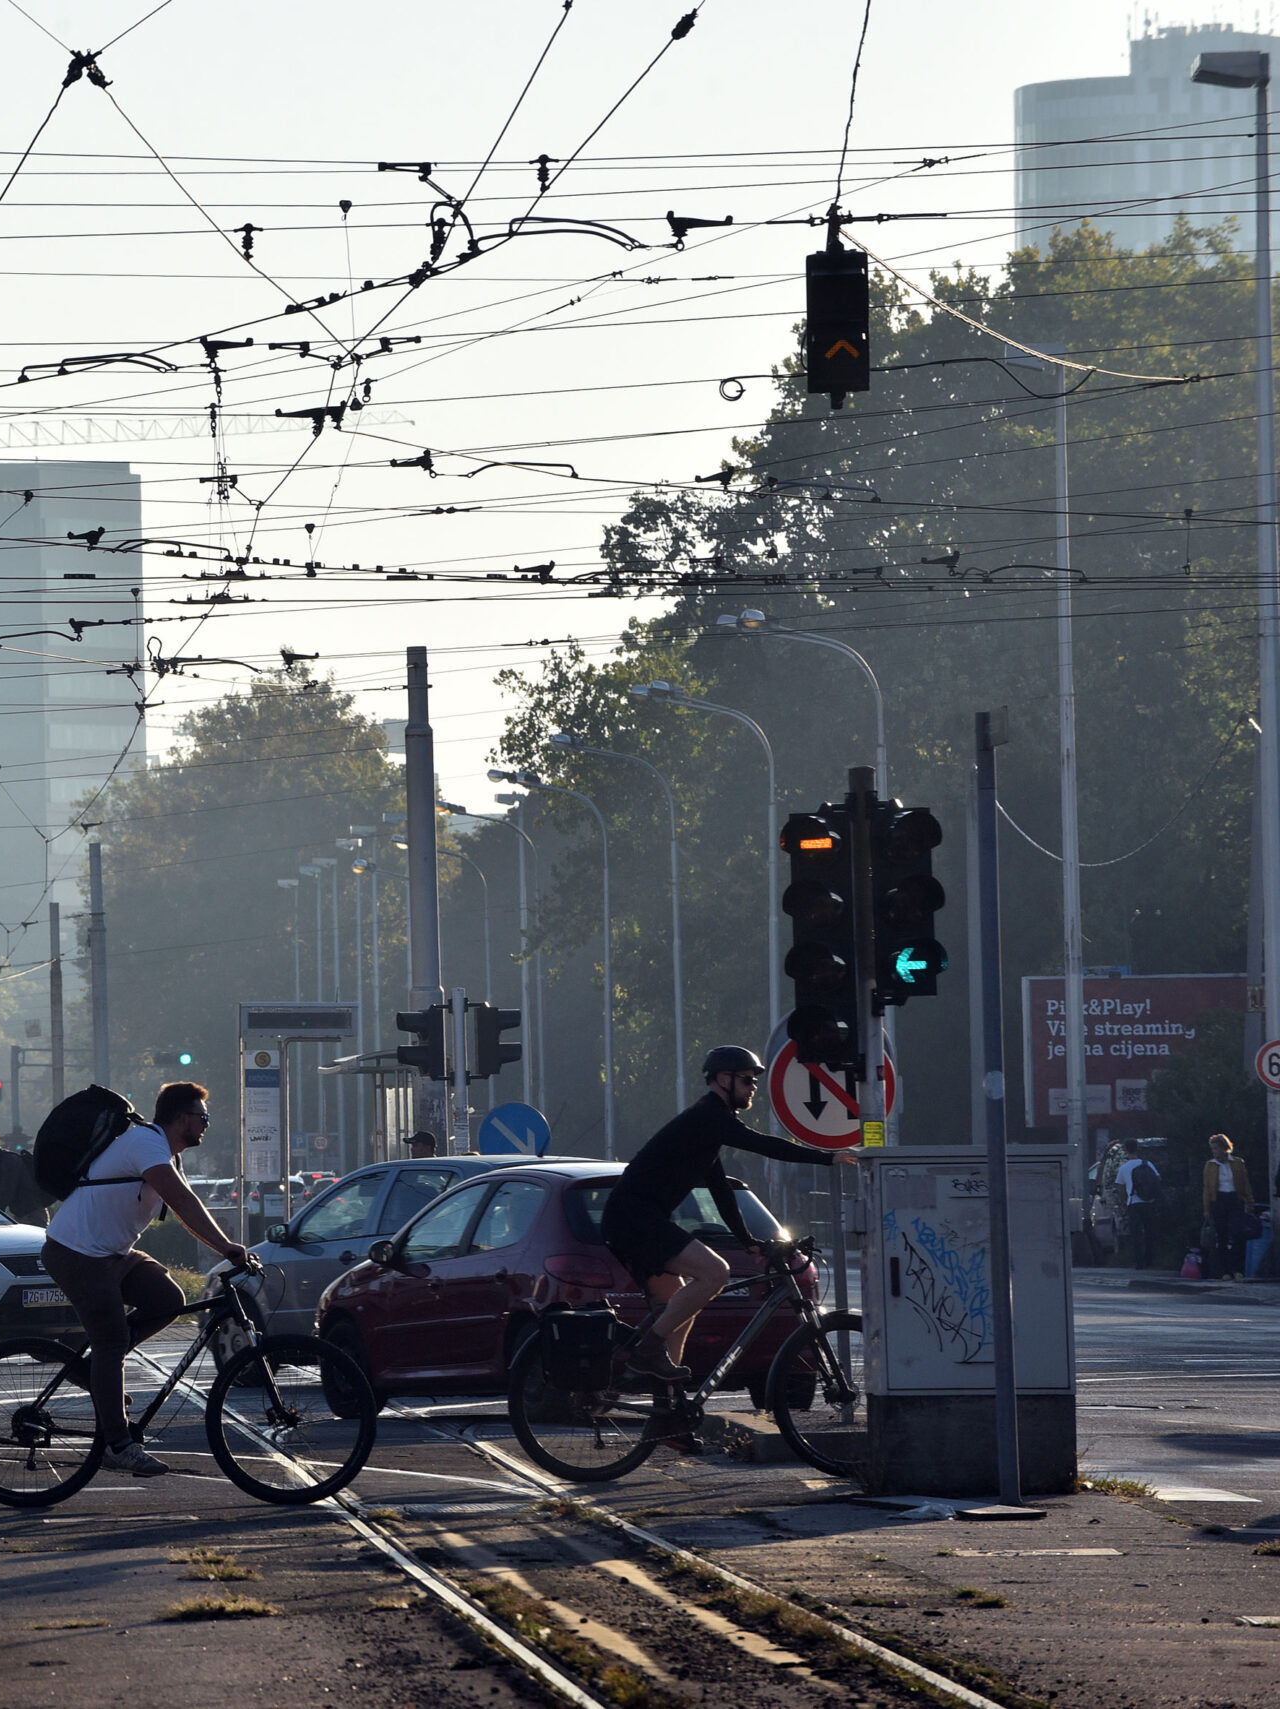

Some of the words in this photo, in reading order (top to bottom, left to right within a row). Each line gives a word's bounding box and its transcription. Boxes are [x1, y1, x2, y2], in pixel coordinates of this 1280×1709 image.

[1046, 998, 1151, 1018] Pik&Play!
[1047, 1041, 1104, 1060] jena
[1110, 1041, 1170, 1059] cijena
[29, 1291, 40, 1303] ZG
